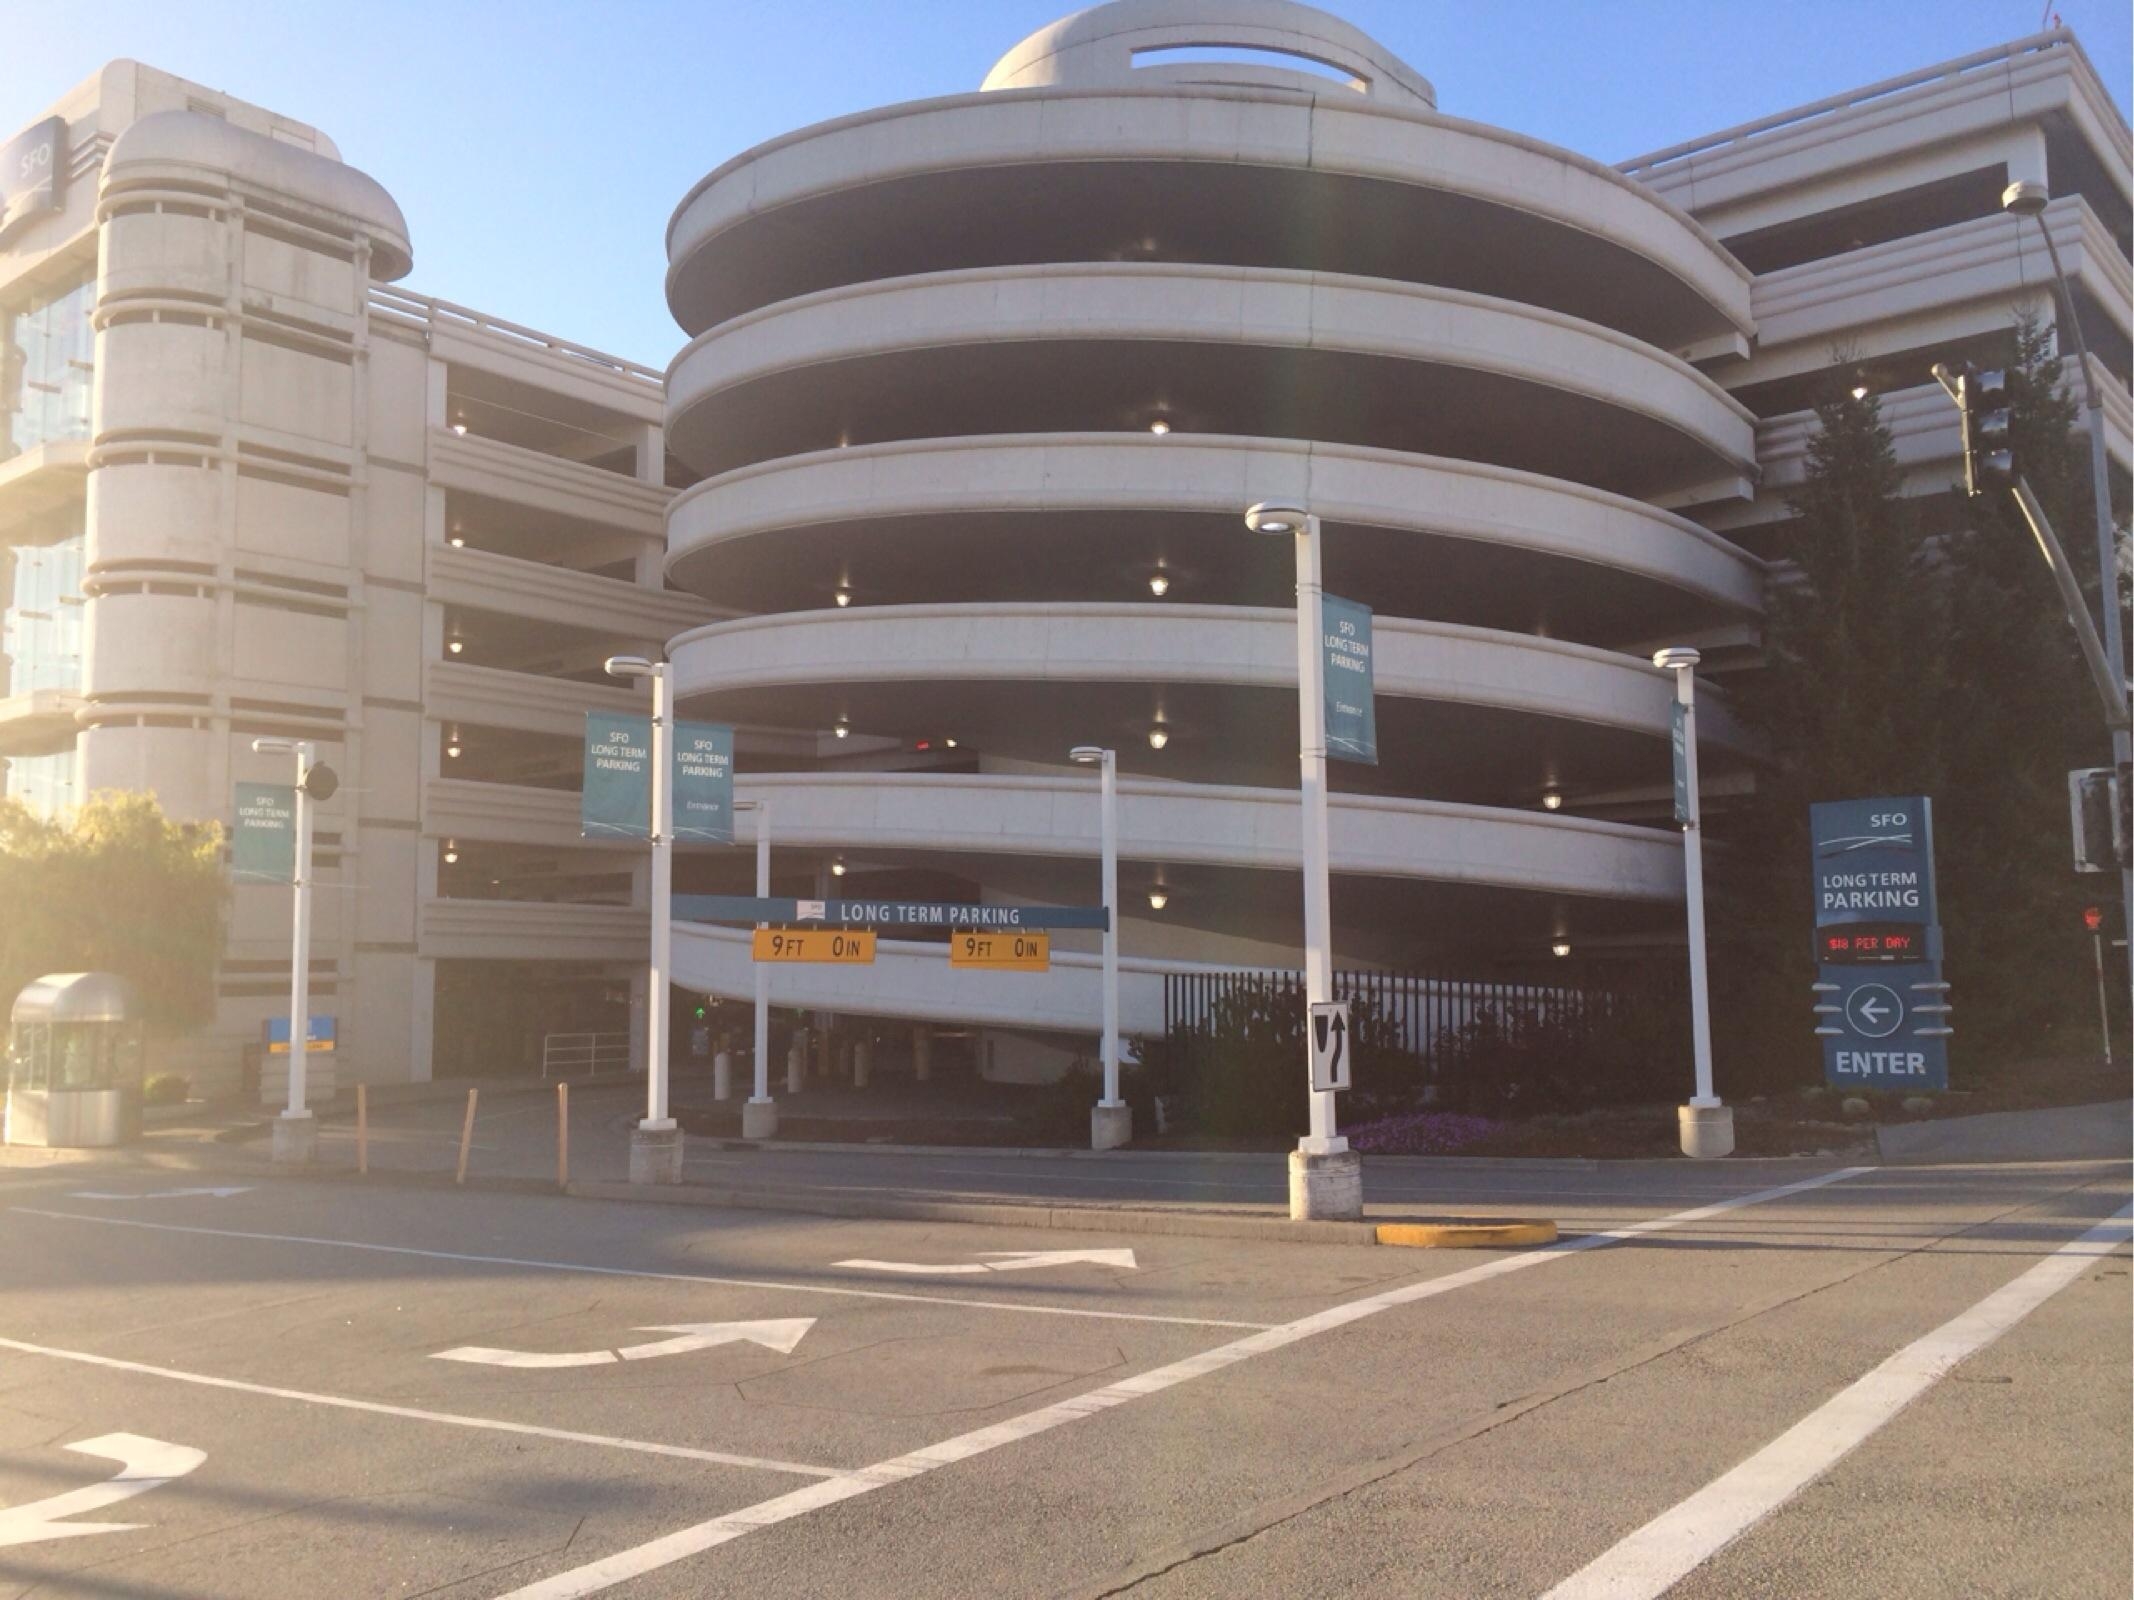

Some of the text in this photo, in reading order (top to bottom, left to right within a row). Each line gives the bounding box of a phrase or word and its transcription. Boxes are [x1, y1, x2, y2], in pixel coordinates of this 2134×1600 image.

[21, 142, 50, 178] SFO
[1339, 621, 1355, 636] SFO
[1325, 635, 1369, 657] LONG TERM
[1331, 653, 1366, 673] PARKING
[609, 732, 629, 743] SFO
[694, 740, 712, 750] SFO
[591, 745, 647, 758] LONG TERM
[677, 752, 729, 765] LONG TERM
[596, 759, 640, 772] PARKING
[682, 766, 723, 778] PARKING
[1870, 813, 1907, 828] SFO
[1823, 872, 1918, 889] LONG TERM
[1824, 890, 1919, 909] PARKING
[841, 904, 1020, 925] LONG TERM PARKING
[1856, 937, 1879, 949] PER
[1886, 936, 1911, 949] DAY
[1836, 1051, 1926, 1075] ENTER
